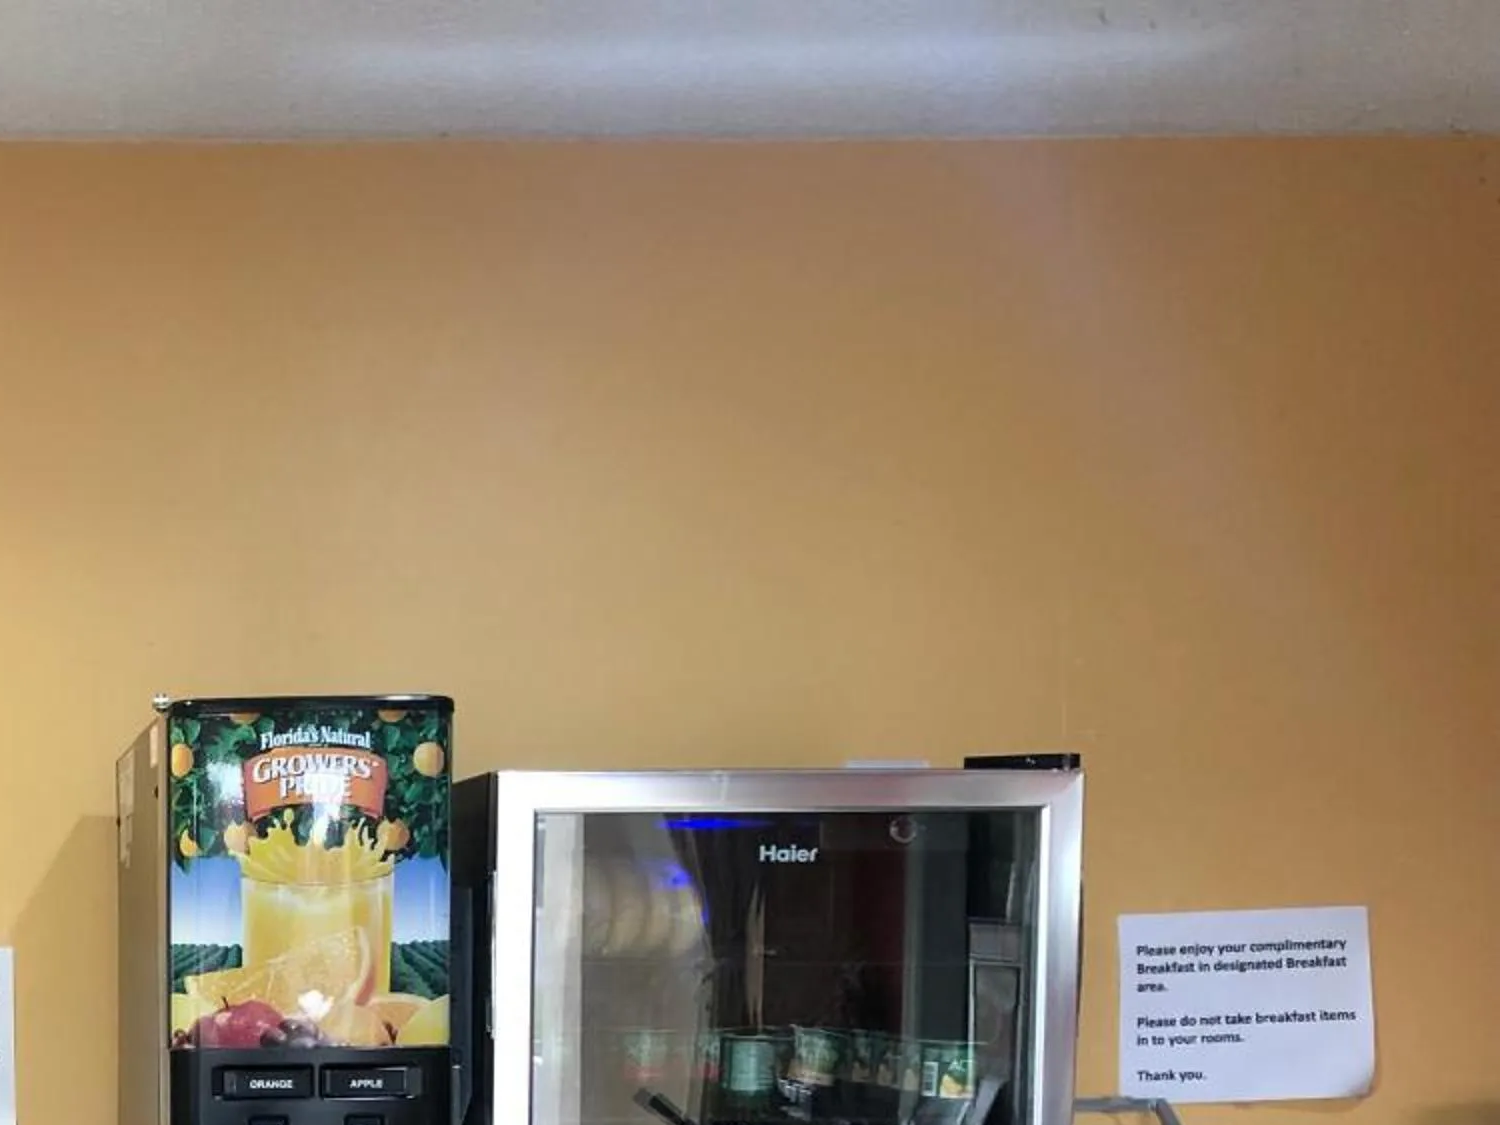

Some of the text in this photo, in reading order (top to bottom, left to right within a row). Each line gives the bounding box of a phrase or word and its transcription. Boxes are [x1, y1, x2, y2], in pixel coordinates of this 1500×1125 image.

[260, 723, 371, 750] Florida's Natural
[759, 844, 819, 862] Haier
[1137, 938, 1347, 957] Please enjoy your complimentary
[1137, 955, 1347, 975] Breakfast in designated Breakfast
[1137, 982, 1167, 993] area.
[1137, 1009, 1356, 1029] Please do not take breakfast items
[1137, 1031, 1244, 1048] in to your rooms.
[1137, 1068, 1206, 1083] Thank you.
[250, 1079, 294, 1090] ORANGE
[350, 1079, 384, 1090] APPLE
